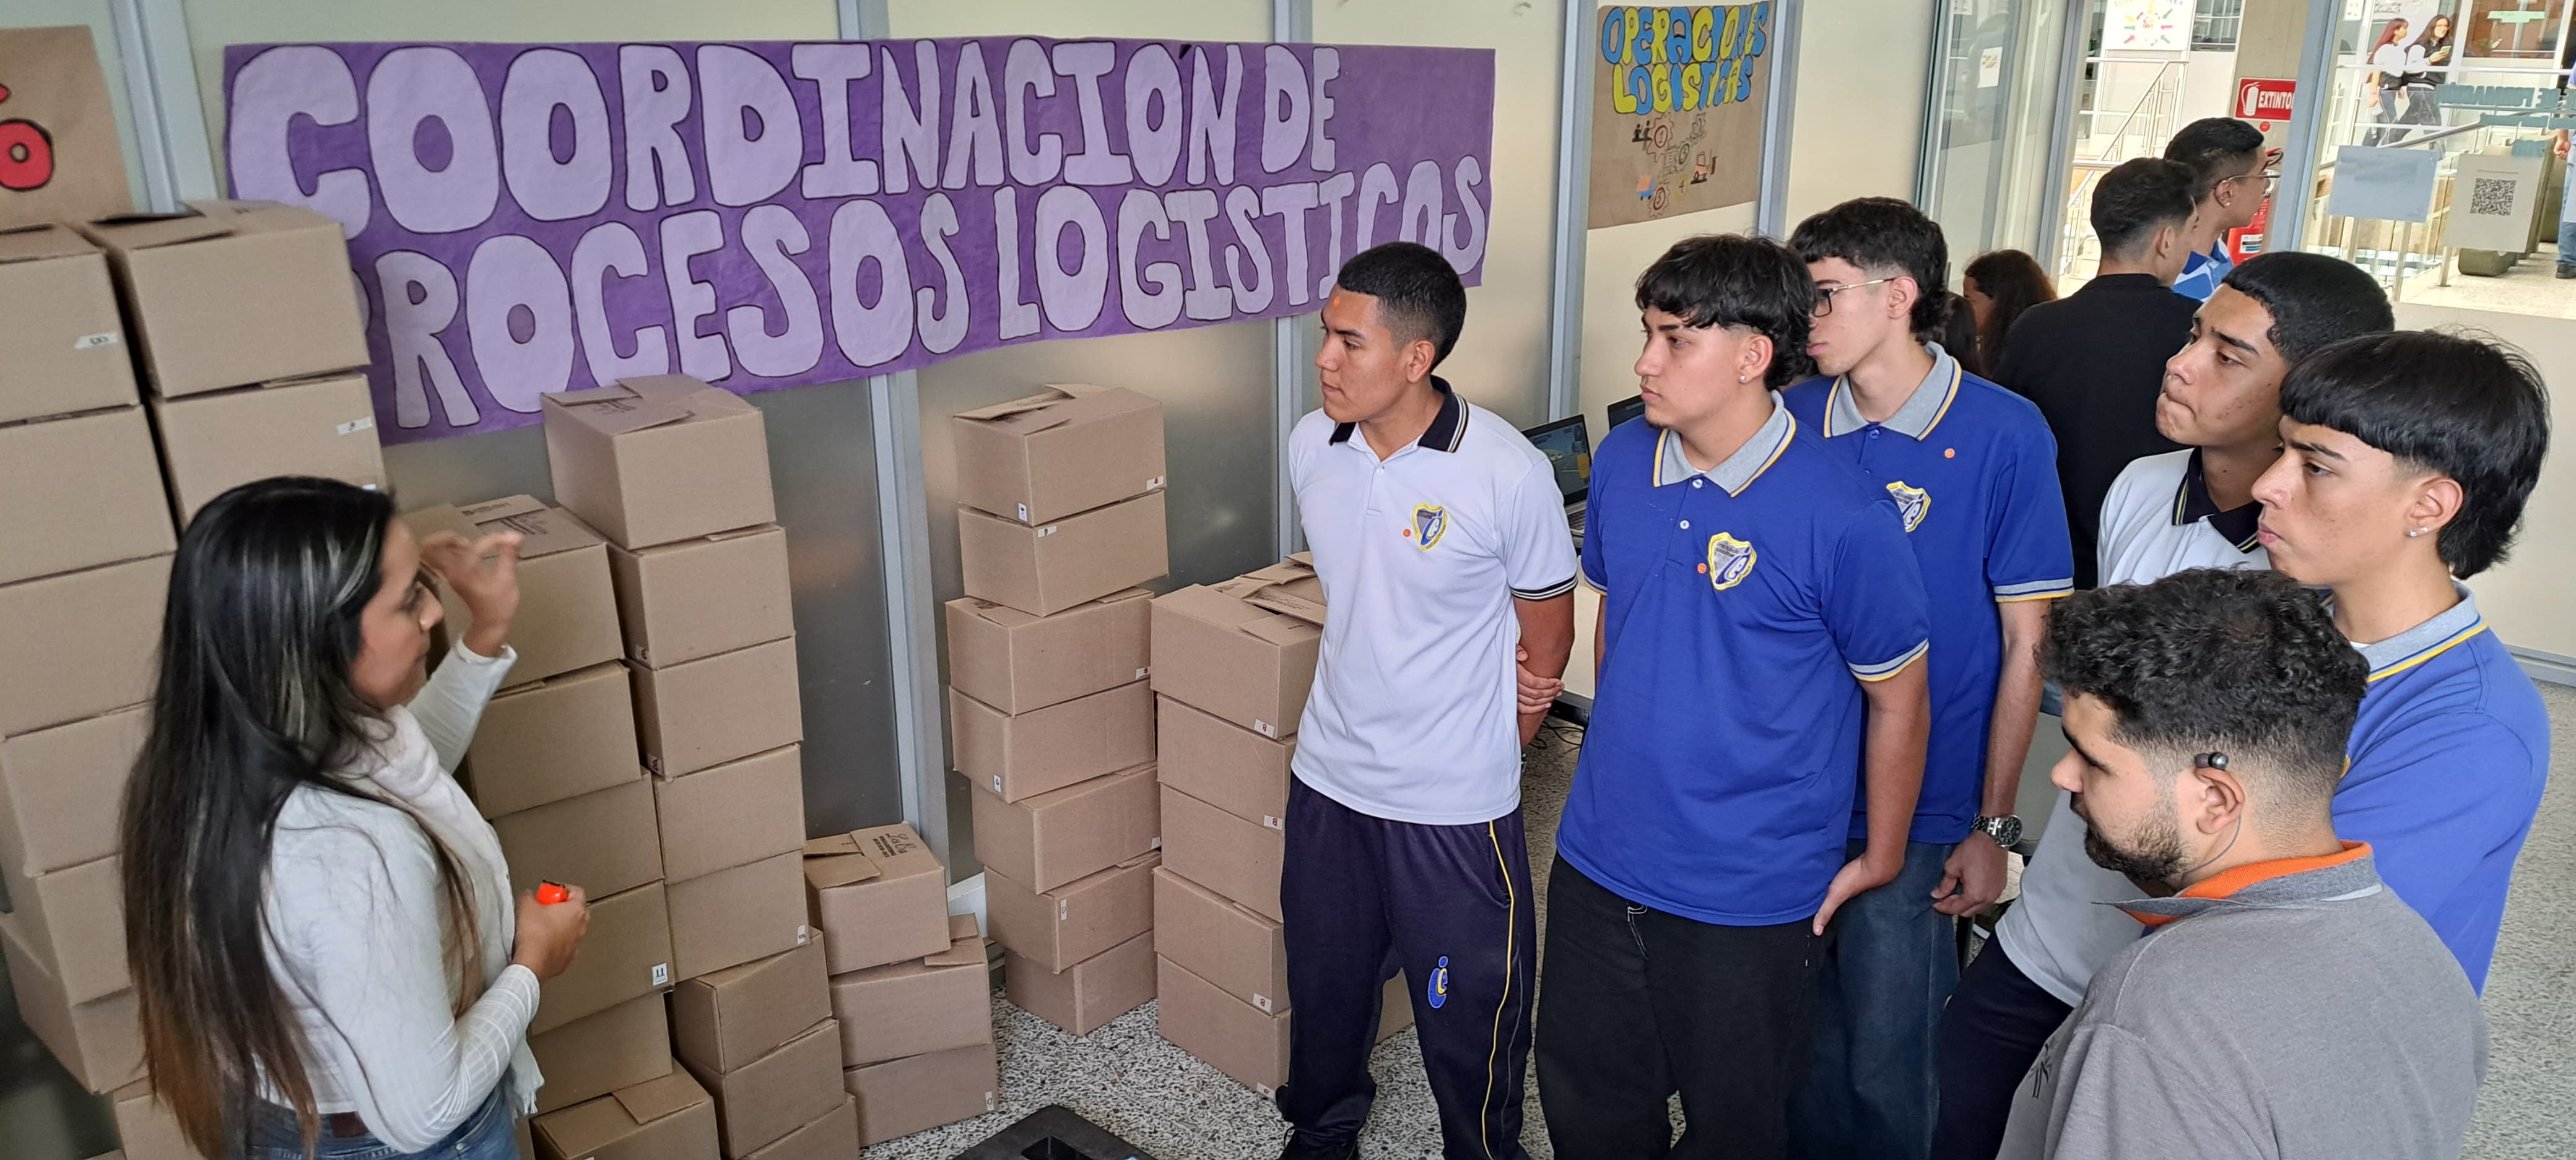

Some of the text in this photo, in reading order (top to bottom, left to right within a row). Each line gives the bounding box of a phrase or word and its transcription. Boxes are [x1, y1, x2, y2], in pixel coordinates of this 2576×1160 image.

[1260, 43, 1341, 175] DE
[1612, 54, 1754, 115] LOGISTICAS
[348, 191, 971, 429] ROCESOS
